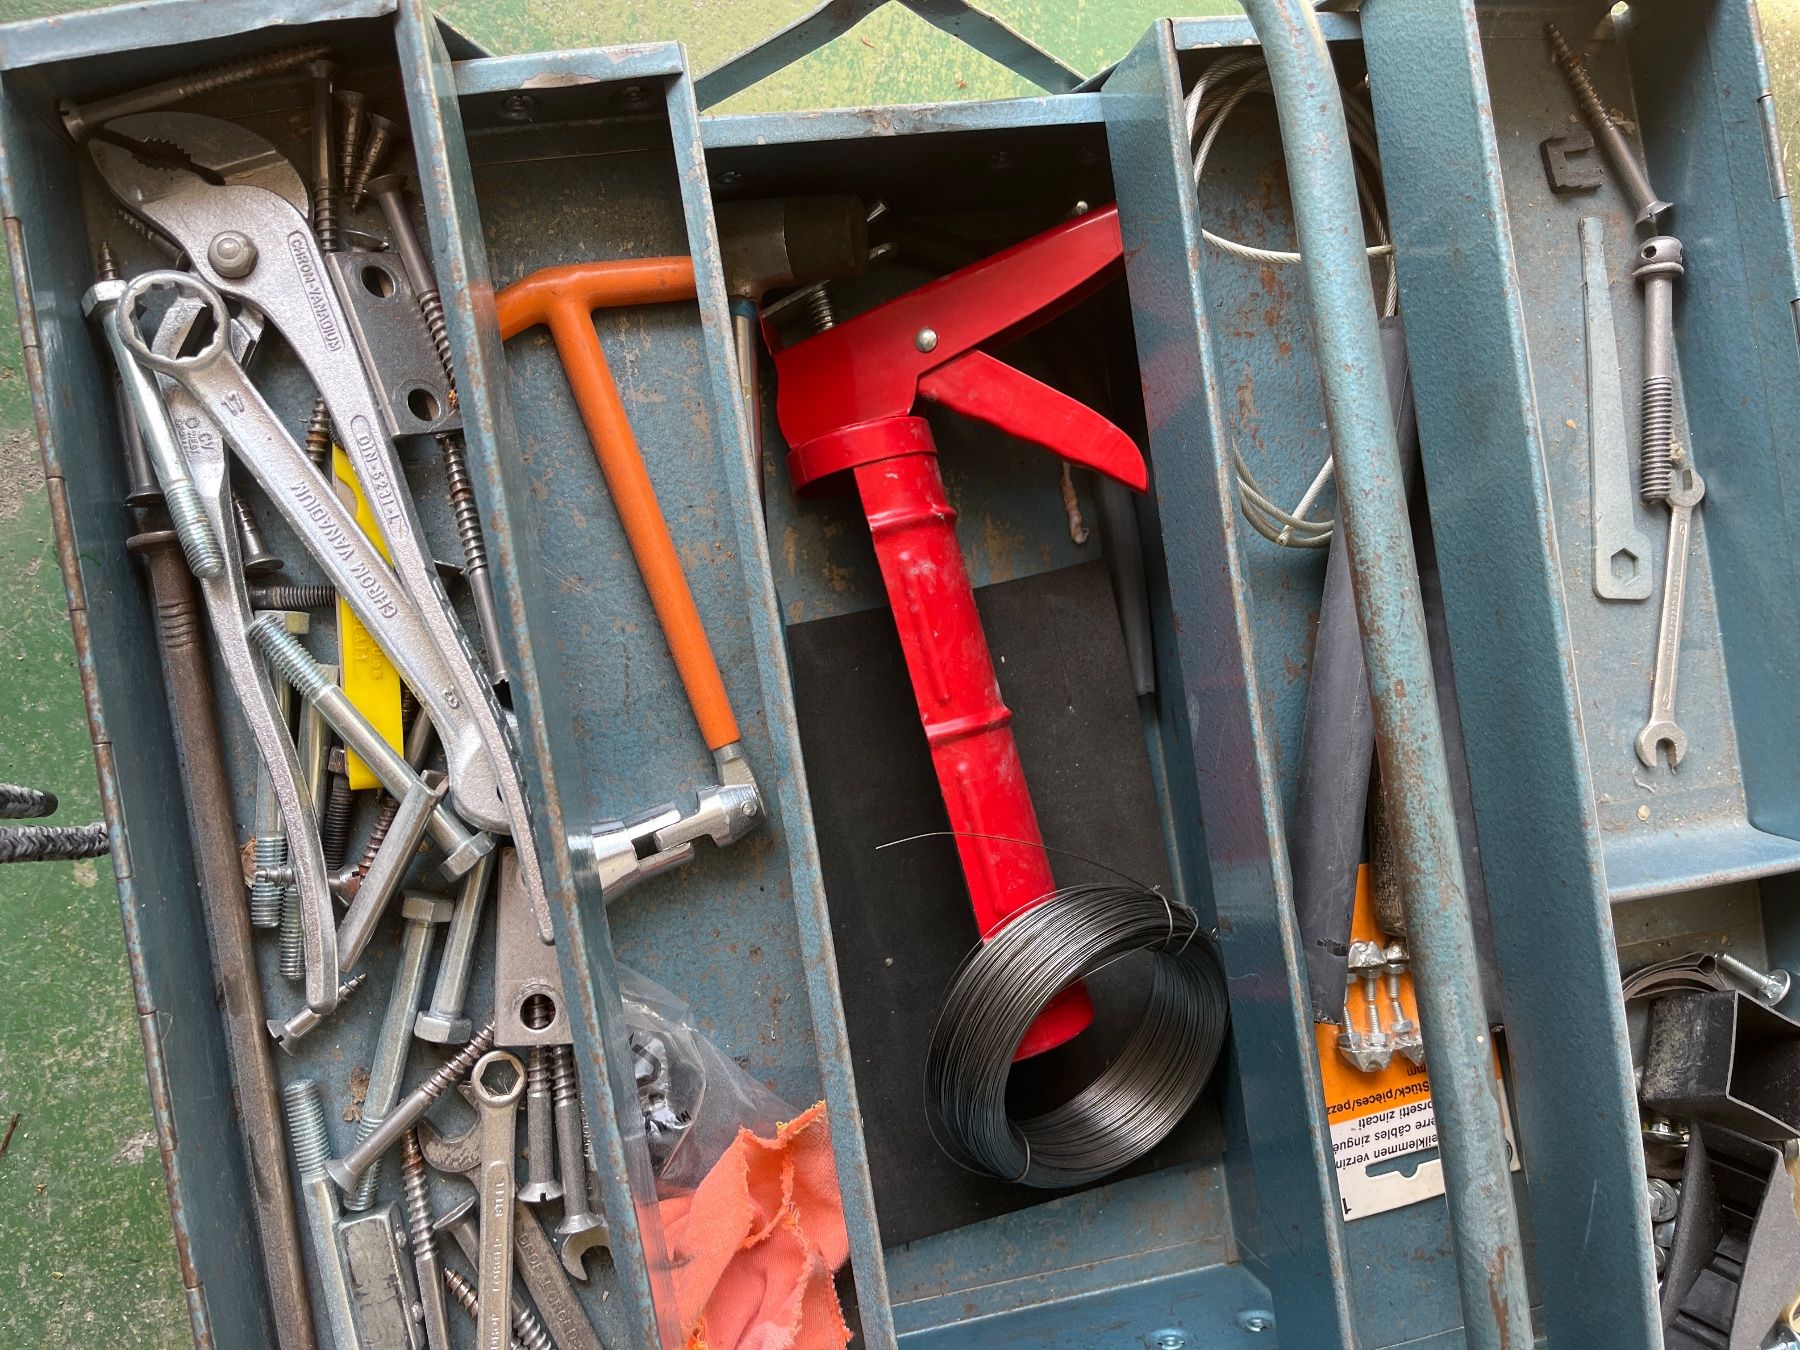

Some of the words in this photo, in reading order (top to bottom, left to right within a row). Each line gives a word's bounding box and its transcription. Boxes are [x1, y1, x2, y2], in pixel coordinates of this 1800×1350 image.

[290, 237, 342, 352] CHROM-VANADIUM
[290, 480, 353, 562] VANADIUM
[350, 561, 398, 619] CHROM
[1358, 1110, 1395, 1131] zincati
[1374, 1124, 1411, 1141] câbles
